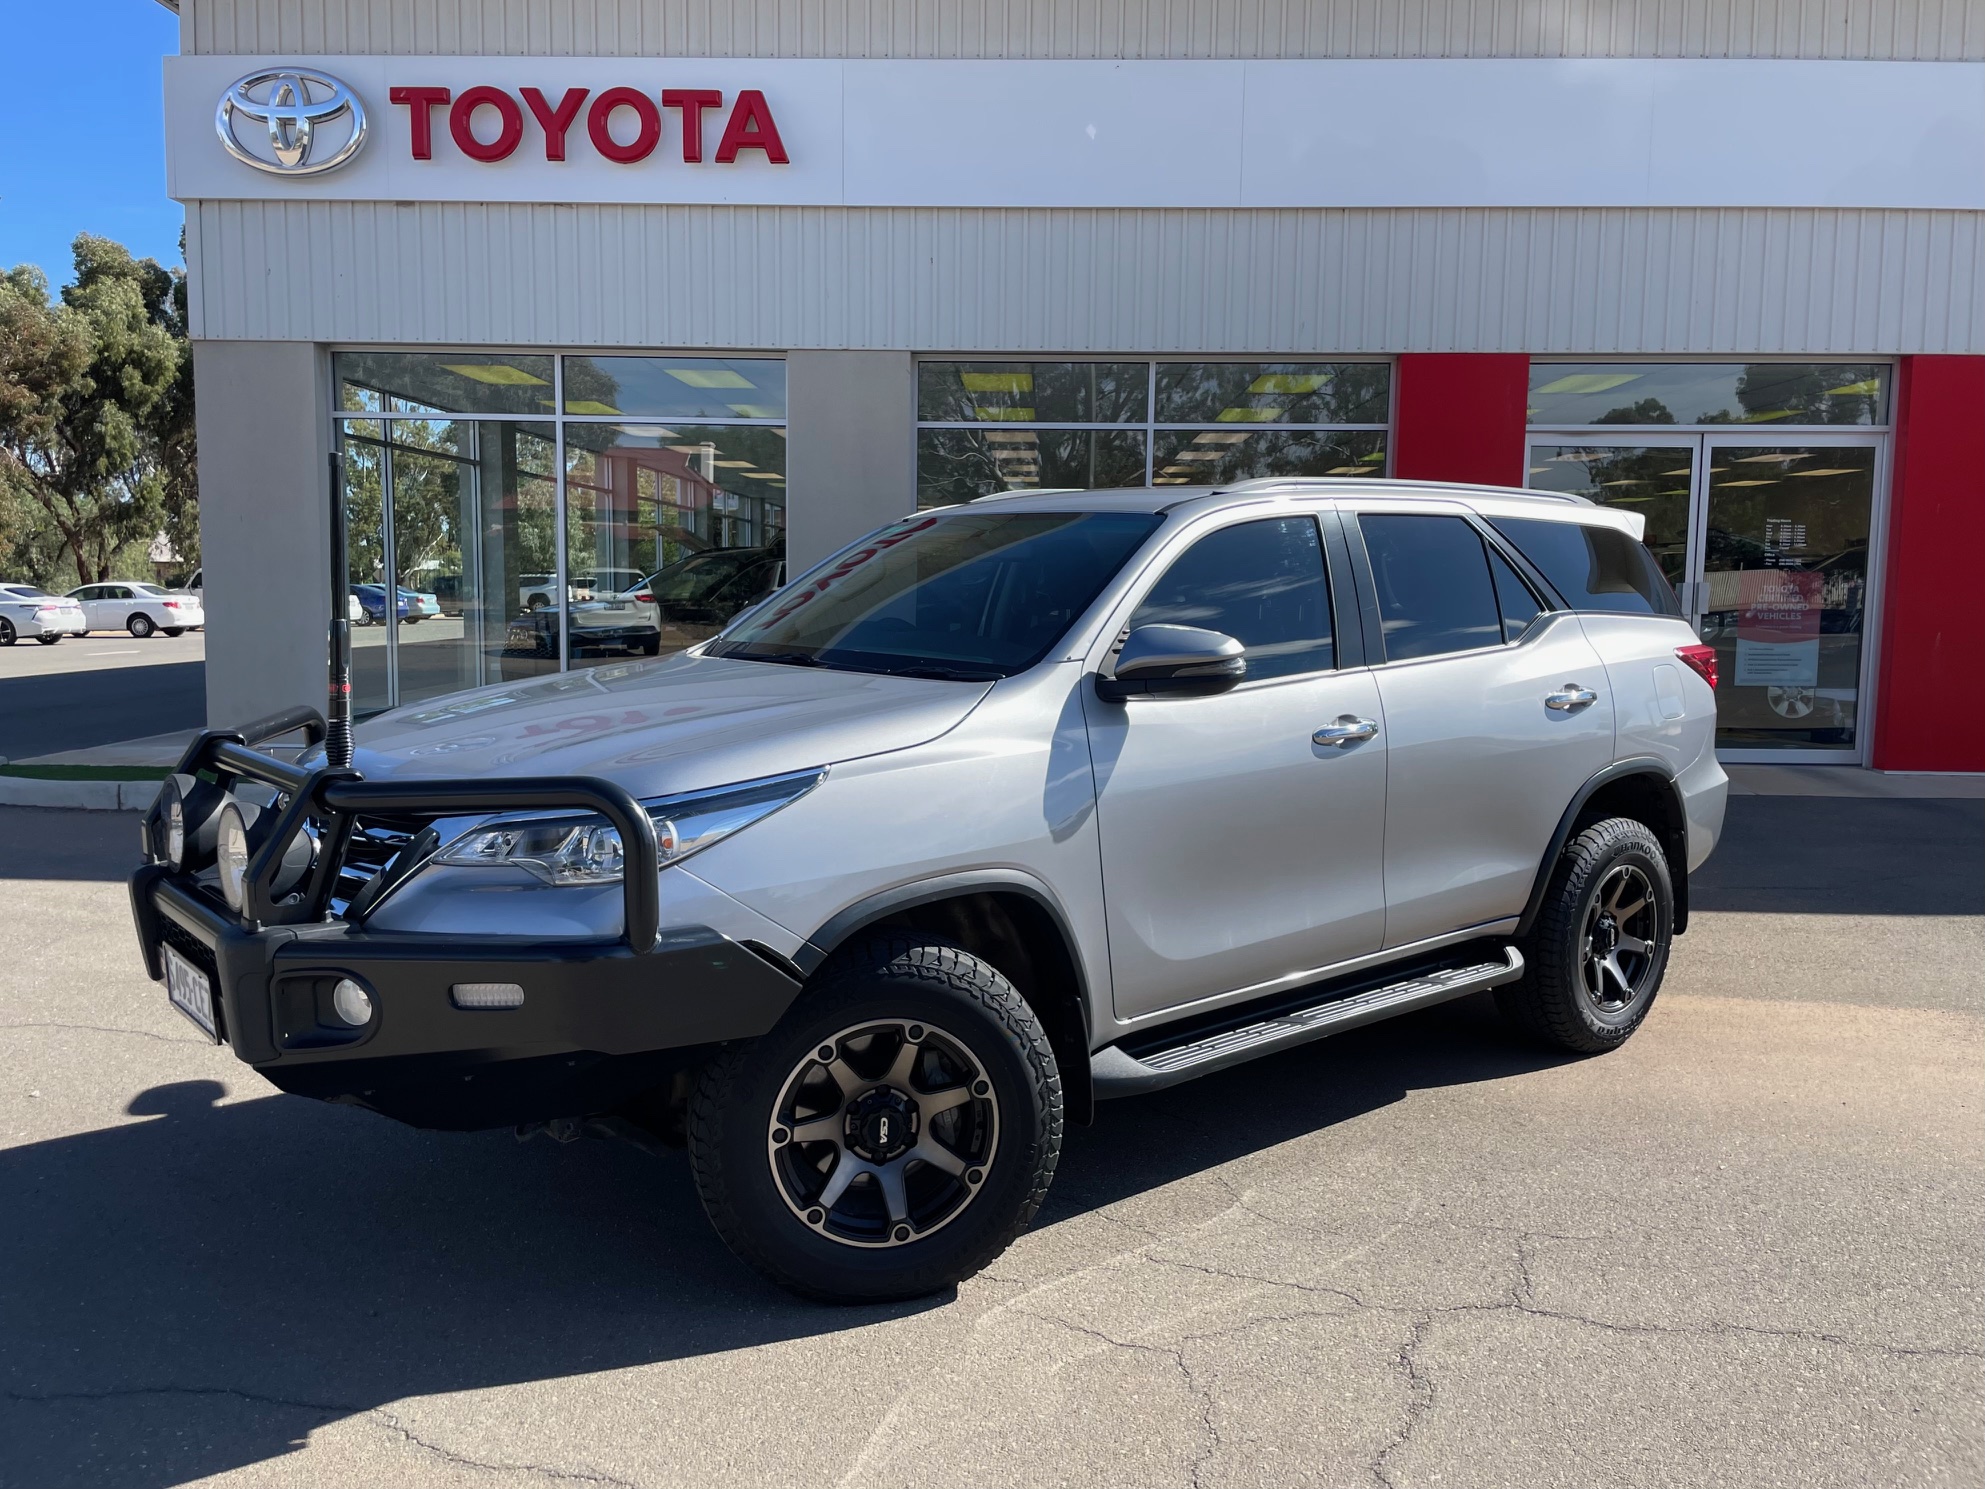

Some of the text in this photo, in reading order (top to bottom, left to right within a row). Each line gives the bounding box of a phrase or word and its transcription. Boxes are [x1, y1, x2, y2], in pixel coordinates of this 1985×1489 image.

[389, 86, 791, 165] TOYOTA
[1751, 603, 1810, 611] PRE-OWNED
[1757, 612, 1802, 620] VEHICLES
[879, 1117, 889, 1144] CSA
